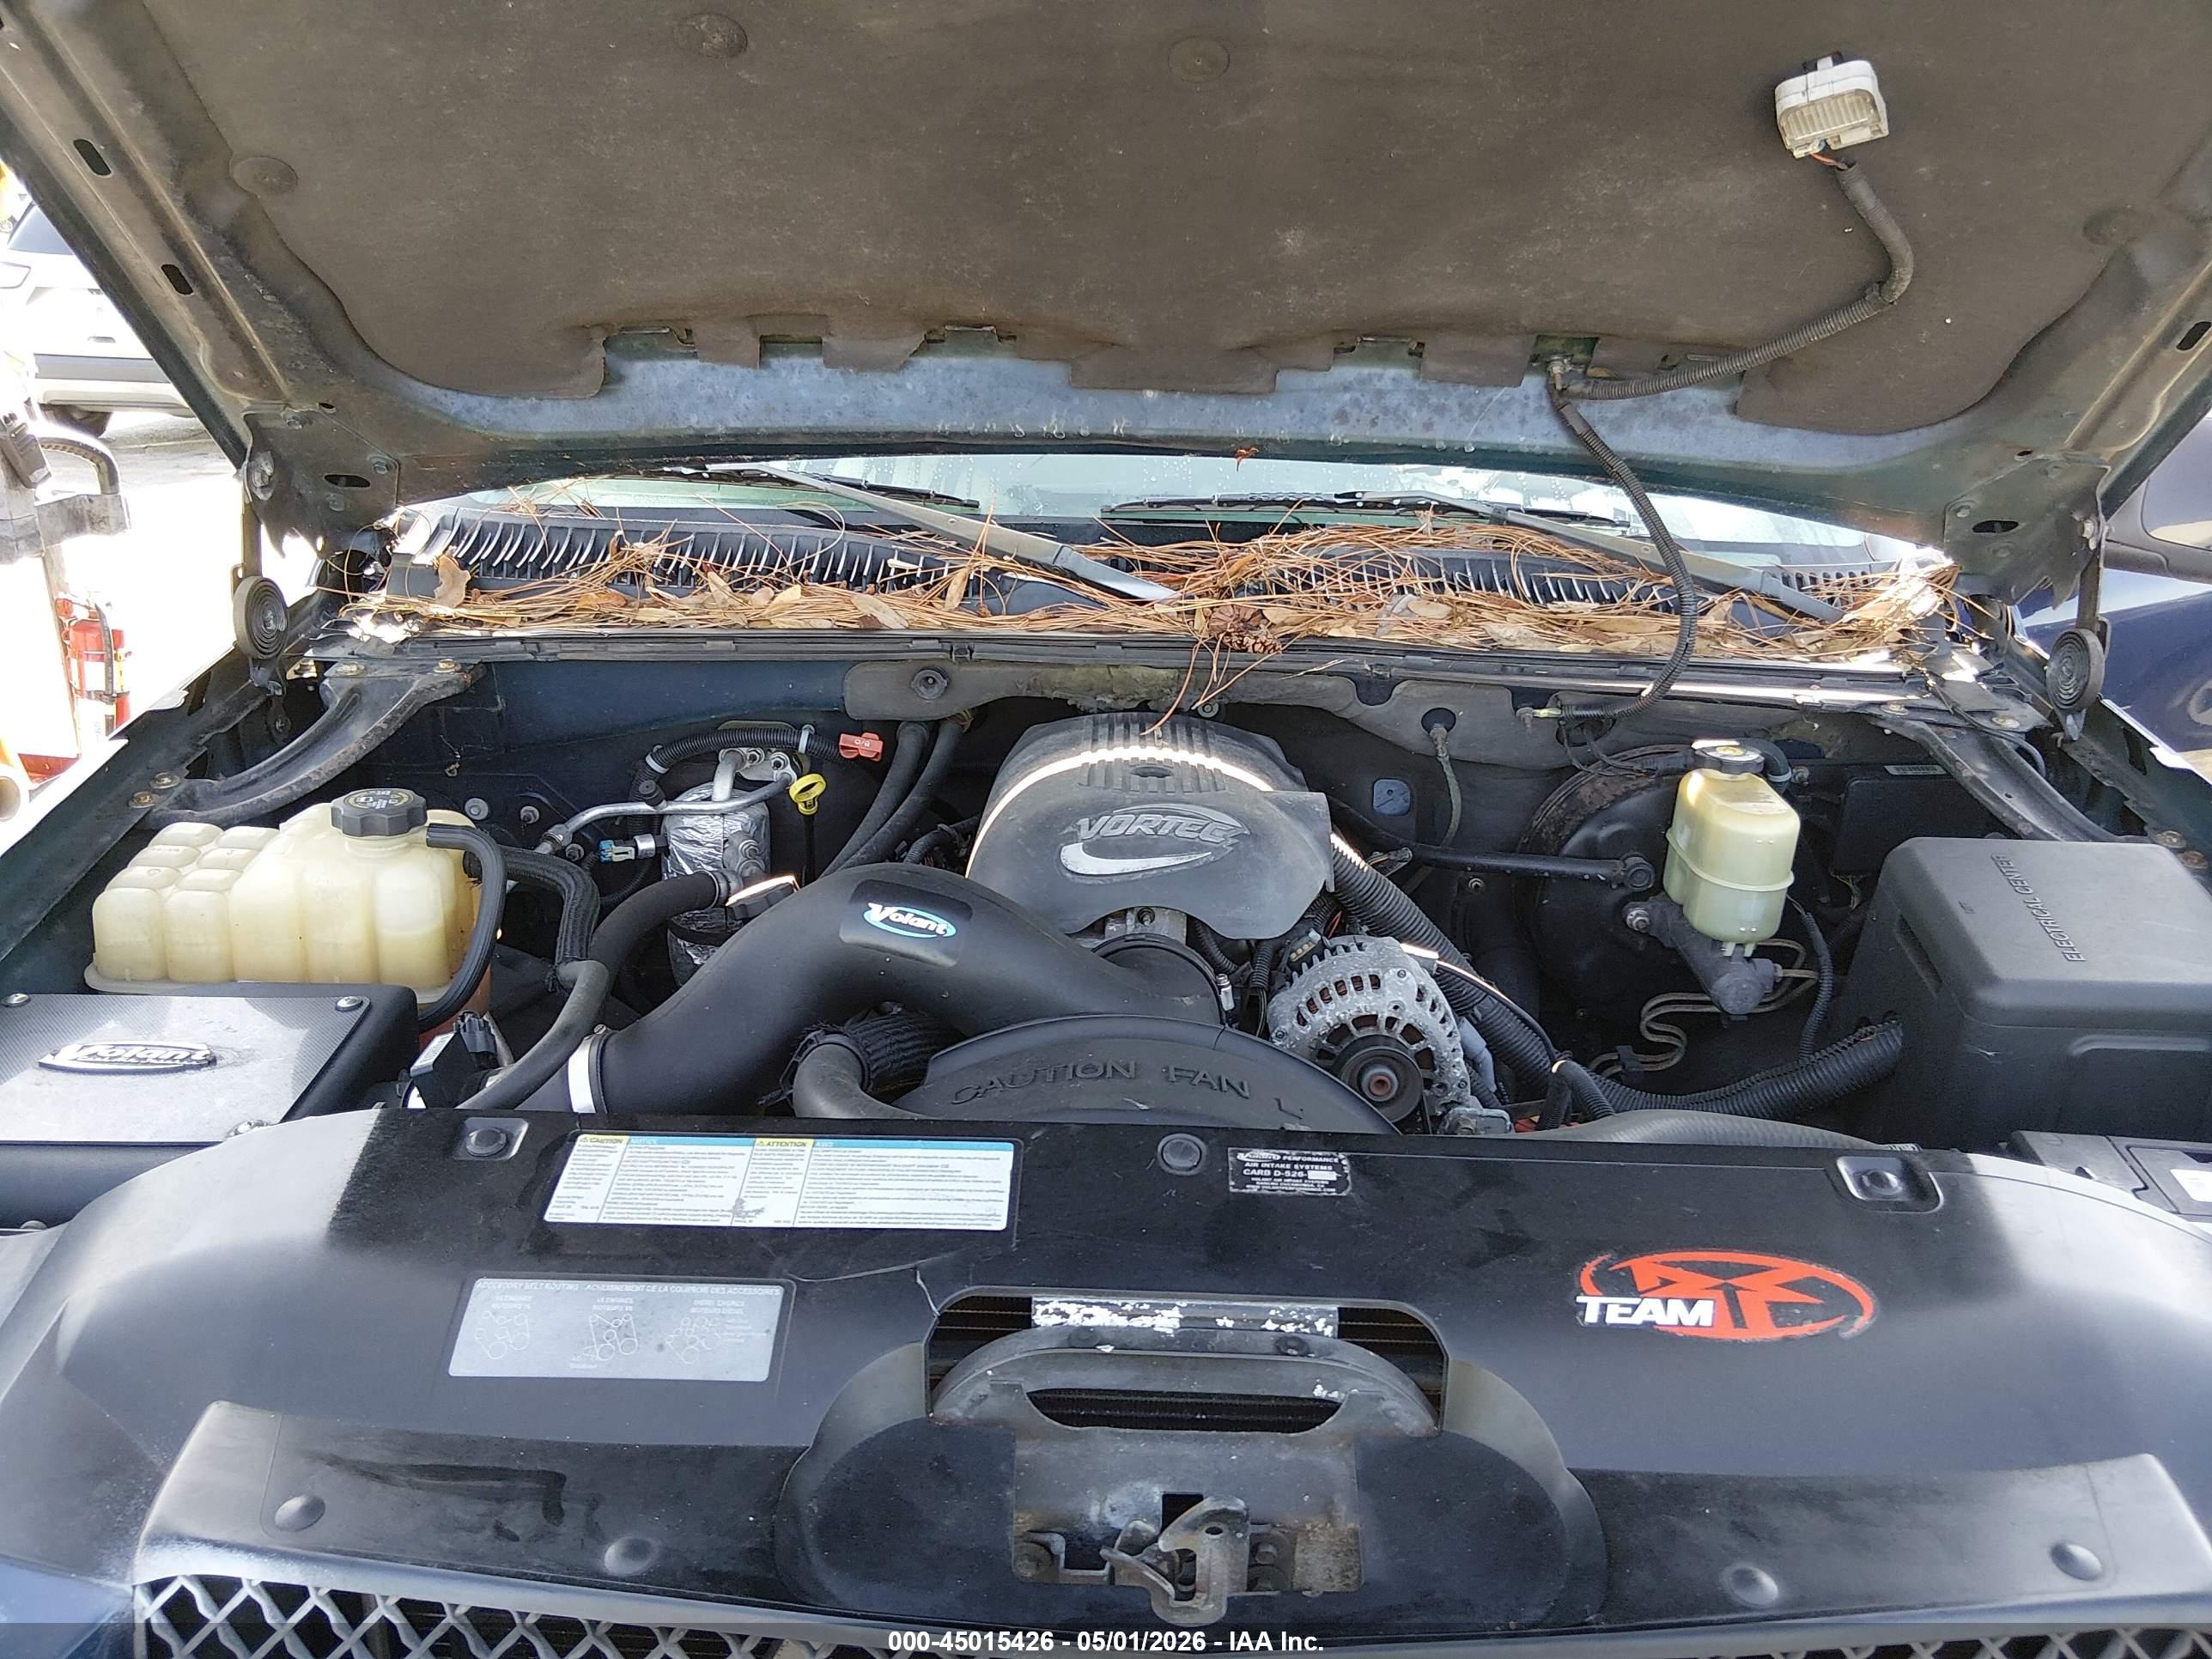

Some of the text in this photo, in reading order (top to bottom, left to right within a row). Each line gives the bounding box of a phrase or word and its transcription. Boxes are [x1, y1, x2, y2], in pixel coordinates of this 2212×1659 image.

[1077, 814, 1235, 845] VORTEC
[867, 902, 949, 936] Volant
[1990, 853, 2088, 963] ELECTRICAL CENTER
[54, 1043, 211, 1062] Volant
[950, 1060, 1251, 1106] CAUTION FAN
[1282, 1155, 1340, 1164] PERFORMANCE
[1576, 1295, 1715, 1327] TEAM
